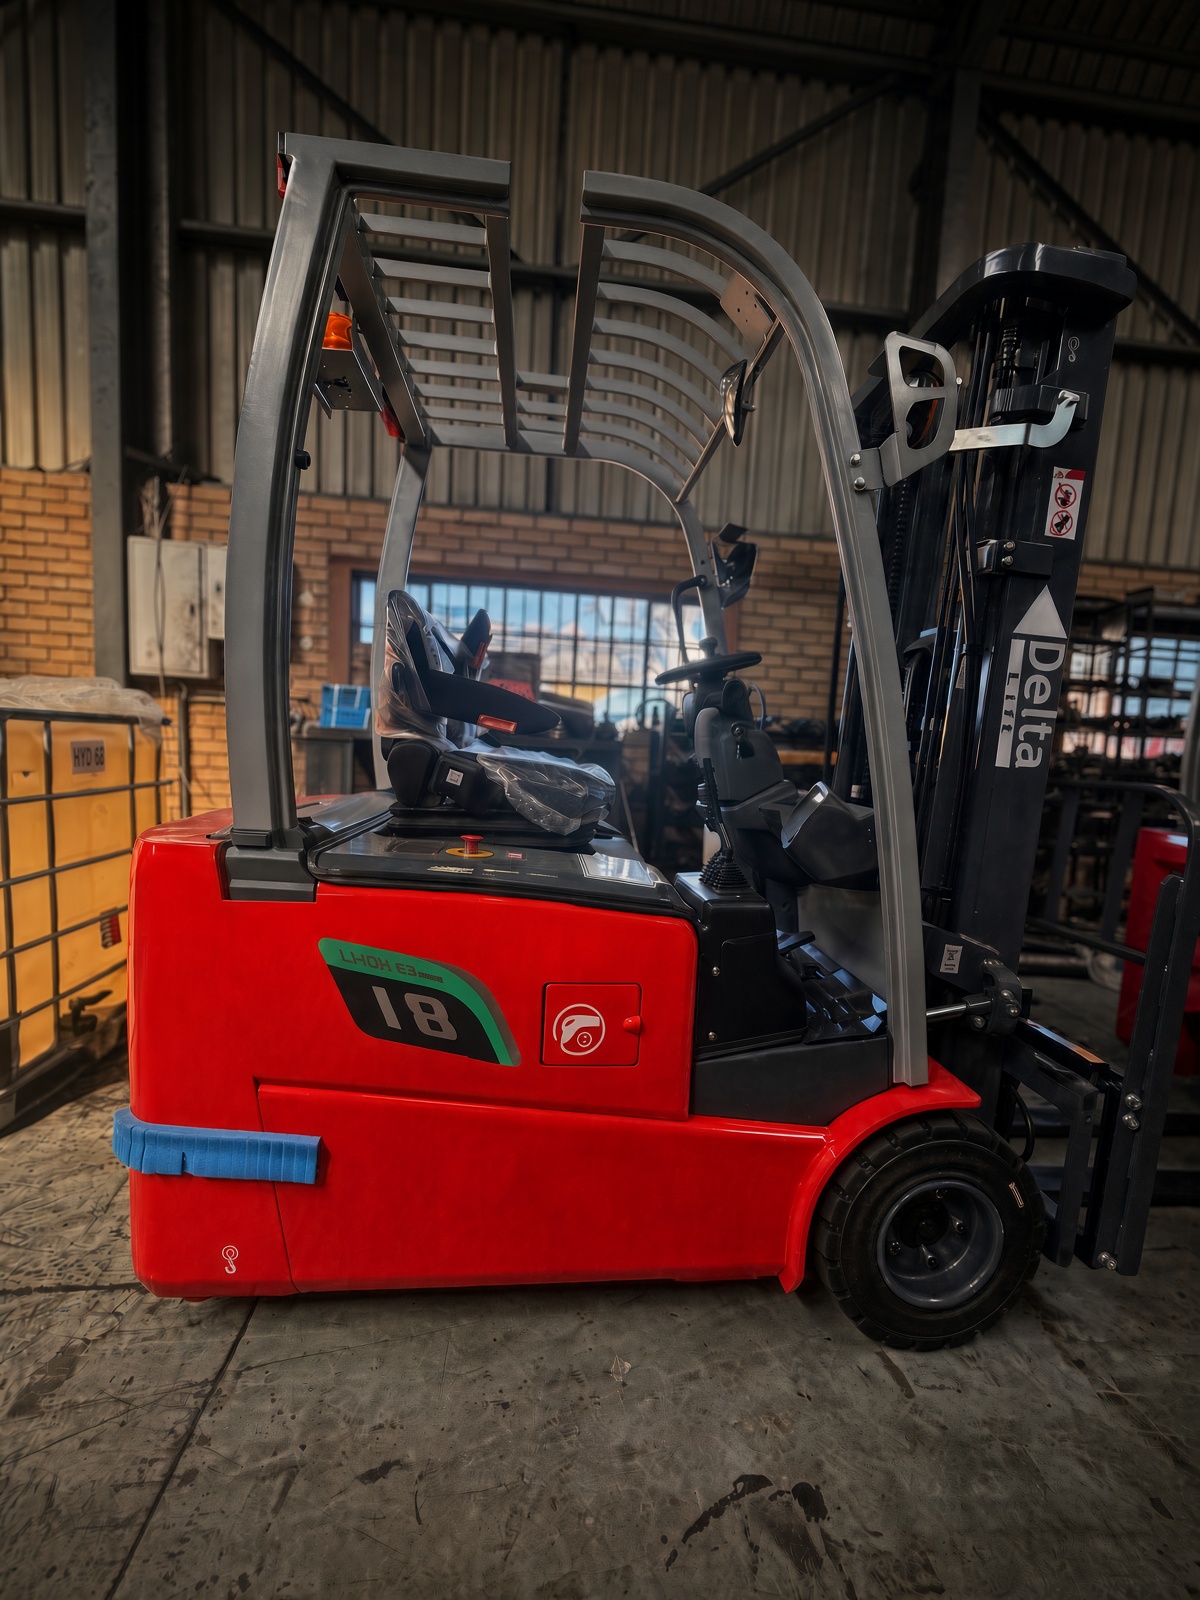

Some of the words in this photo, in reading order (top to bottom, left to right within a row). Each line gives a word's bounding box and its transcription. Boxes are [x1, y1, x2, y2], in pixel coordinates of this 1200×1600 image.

[1015, 640, 1066, 769] Delta
[73, 747, 92, 767] HYD
[95, 746, 105, 766] 68
[372, 985, 458, 1041] 18
